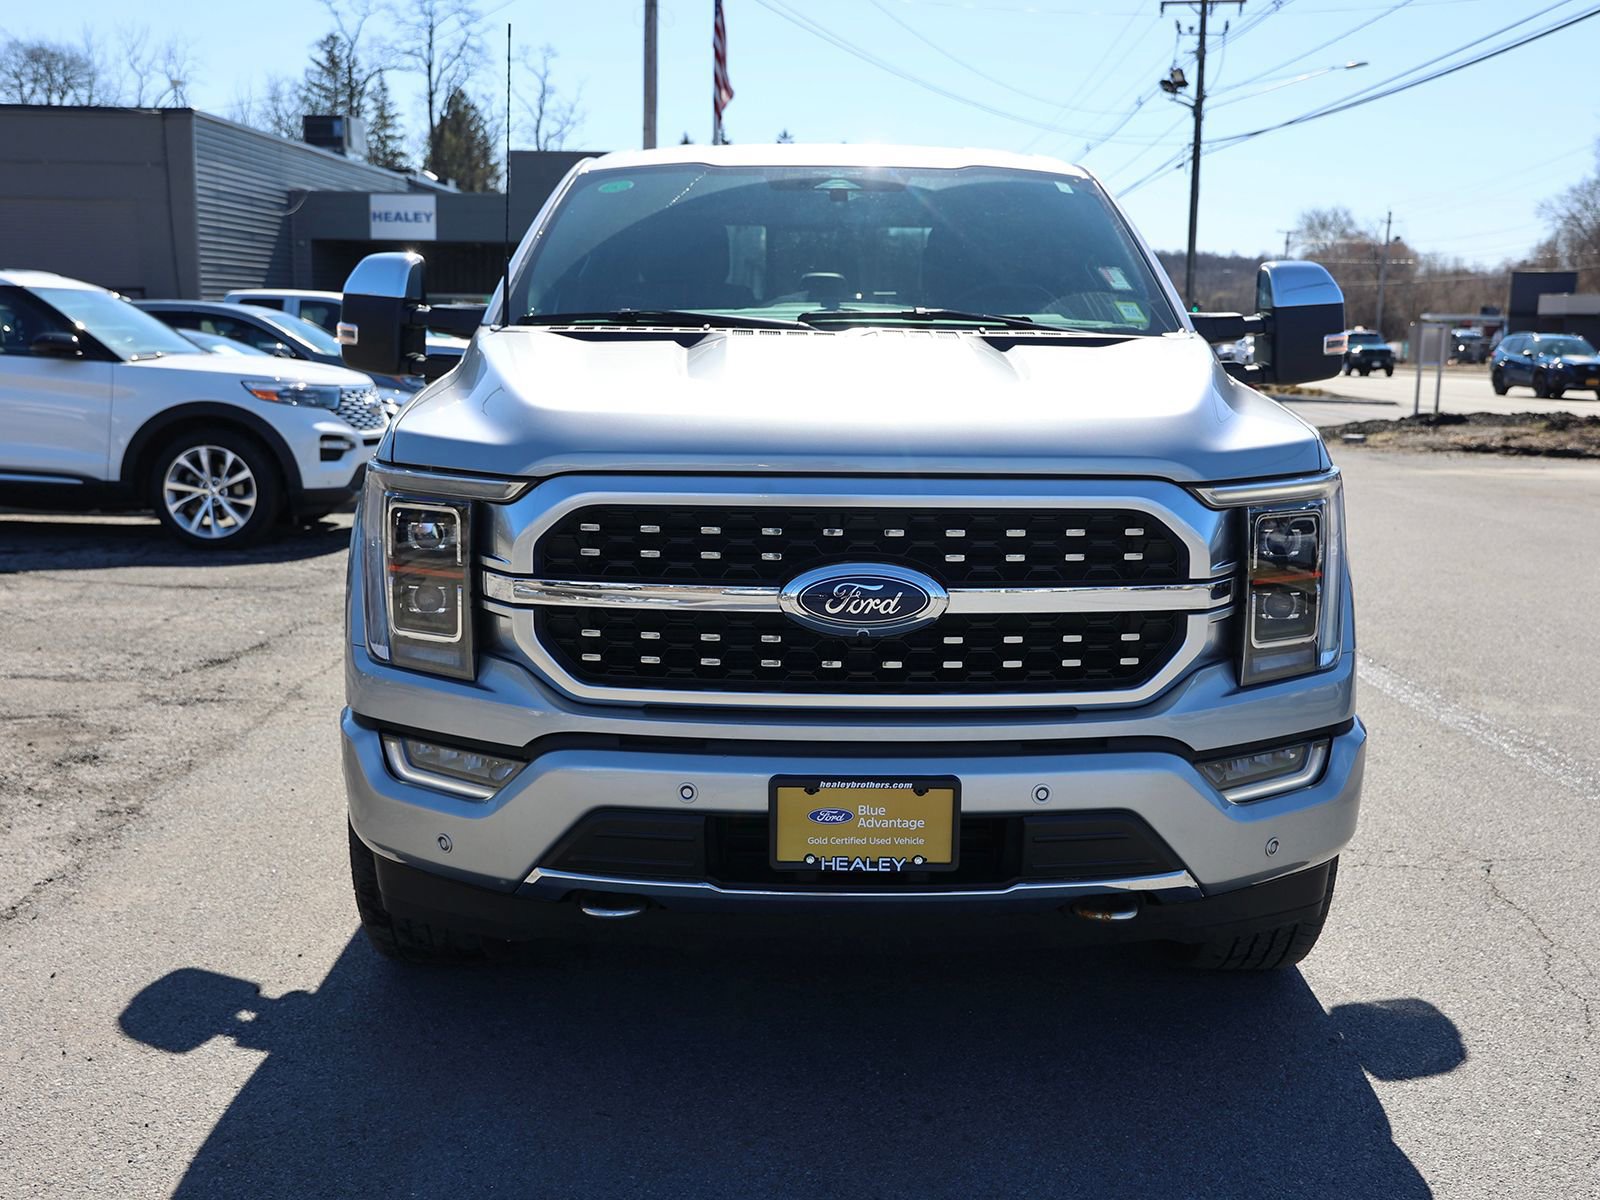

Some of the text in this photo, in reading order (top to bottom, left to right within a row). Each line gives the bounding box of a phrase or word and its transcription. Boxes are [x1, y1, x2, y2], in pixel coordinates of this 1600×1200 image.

[372, 211, 433, 223] HEALEY
[825, 582, 903, 615] Ford
[819, 781, 913, 789] healeybrothers.com
[816, 810, 845, 822] Ford
[857, 805, 886, 816] Blue
[857, 817, 925, 830] Advantage
[807, 836, 925, 845] Gold Certified Used Vehicle
[821, 857, 907, 871] HEALEY
